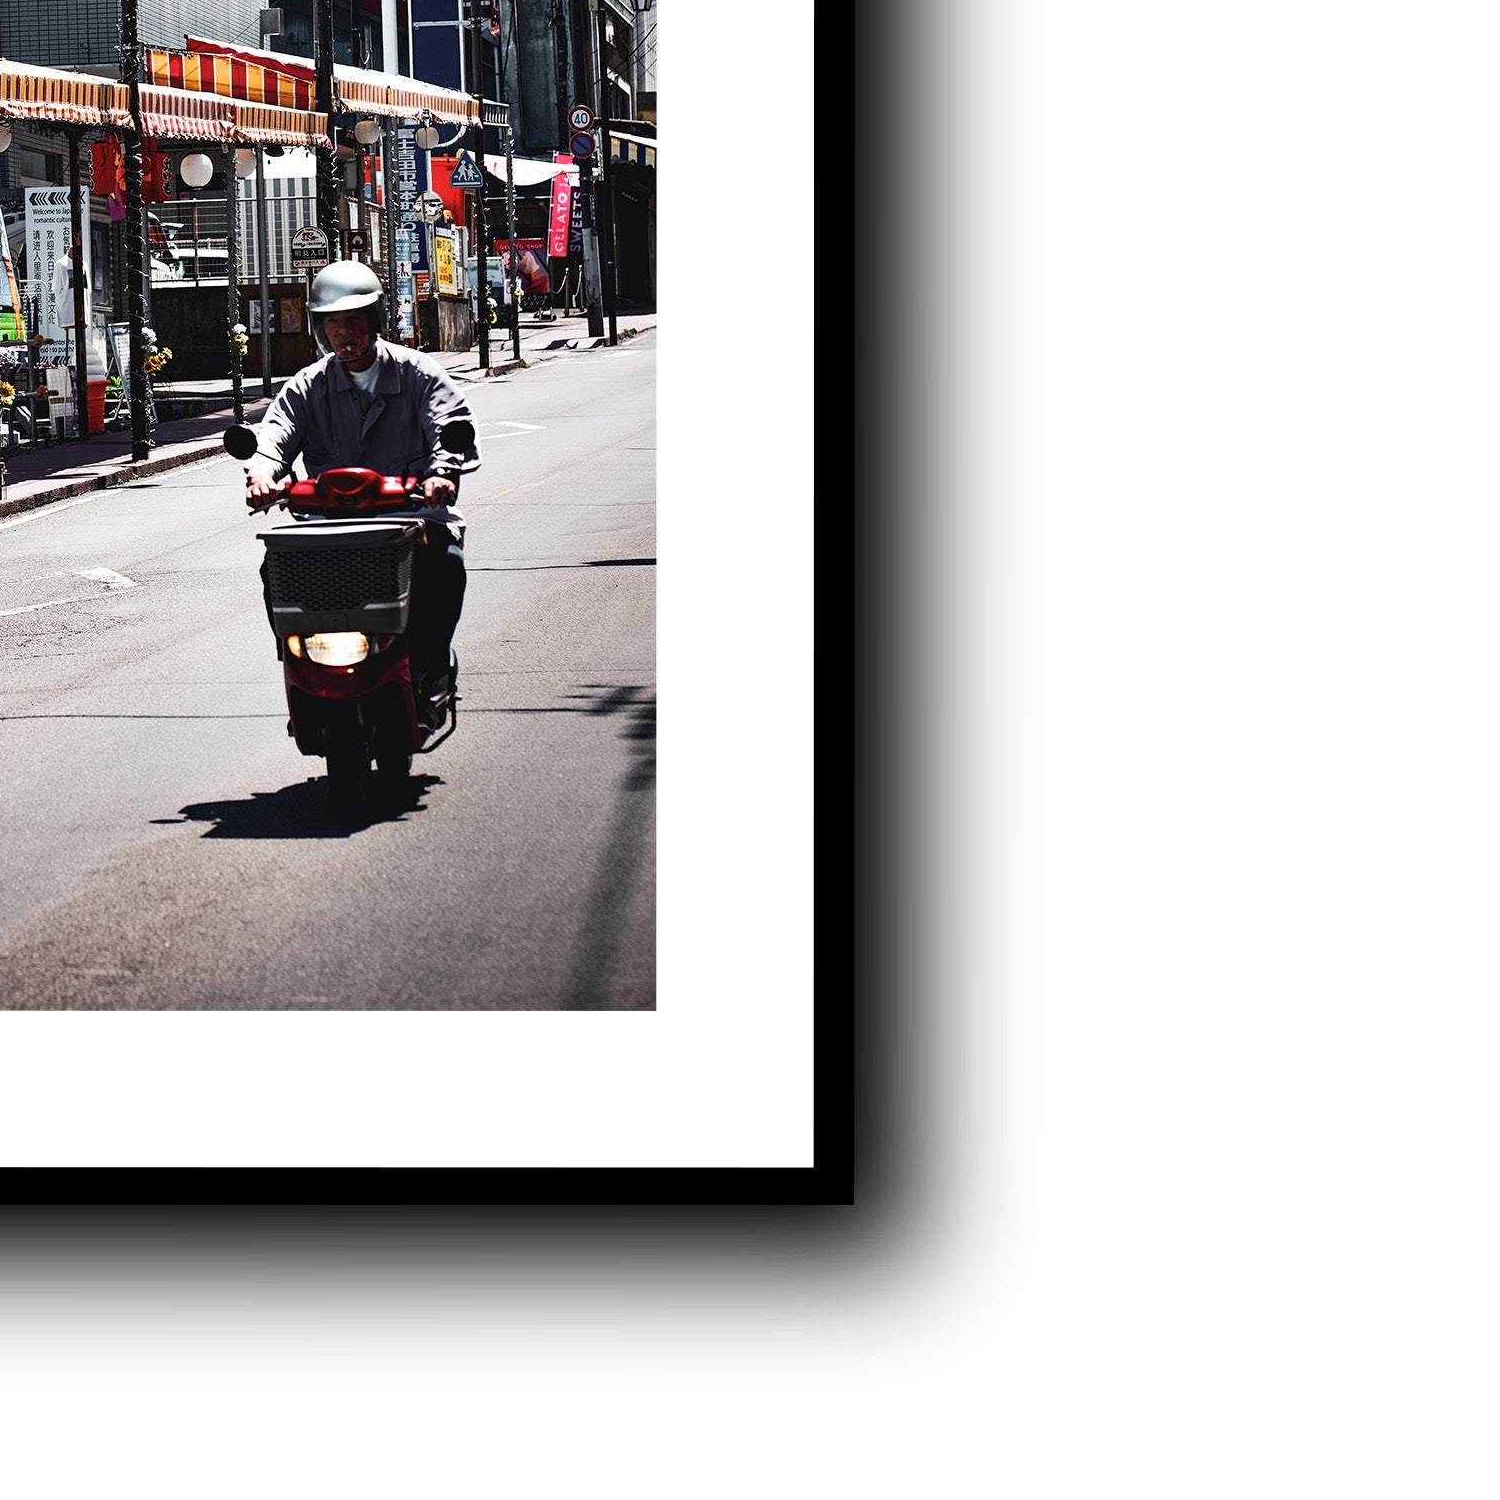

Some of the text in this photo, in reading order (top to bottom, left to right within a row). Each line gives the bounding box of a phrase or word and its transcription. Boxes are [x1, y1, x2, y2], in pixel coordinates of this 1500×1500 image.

[574, 112, 588, 125] 40
[554, 192, 568, 252] GELATO
[569, 191, 583, 252] SWEETS
